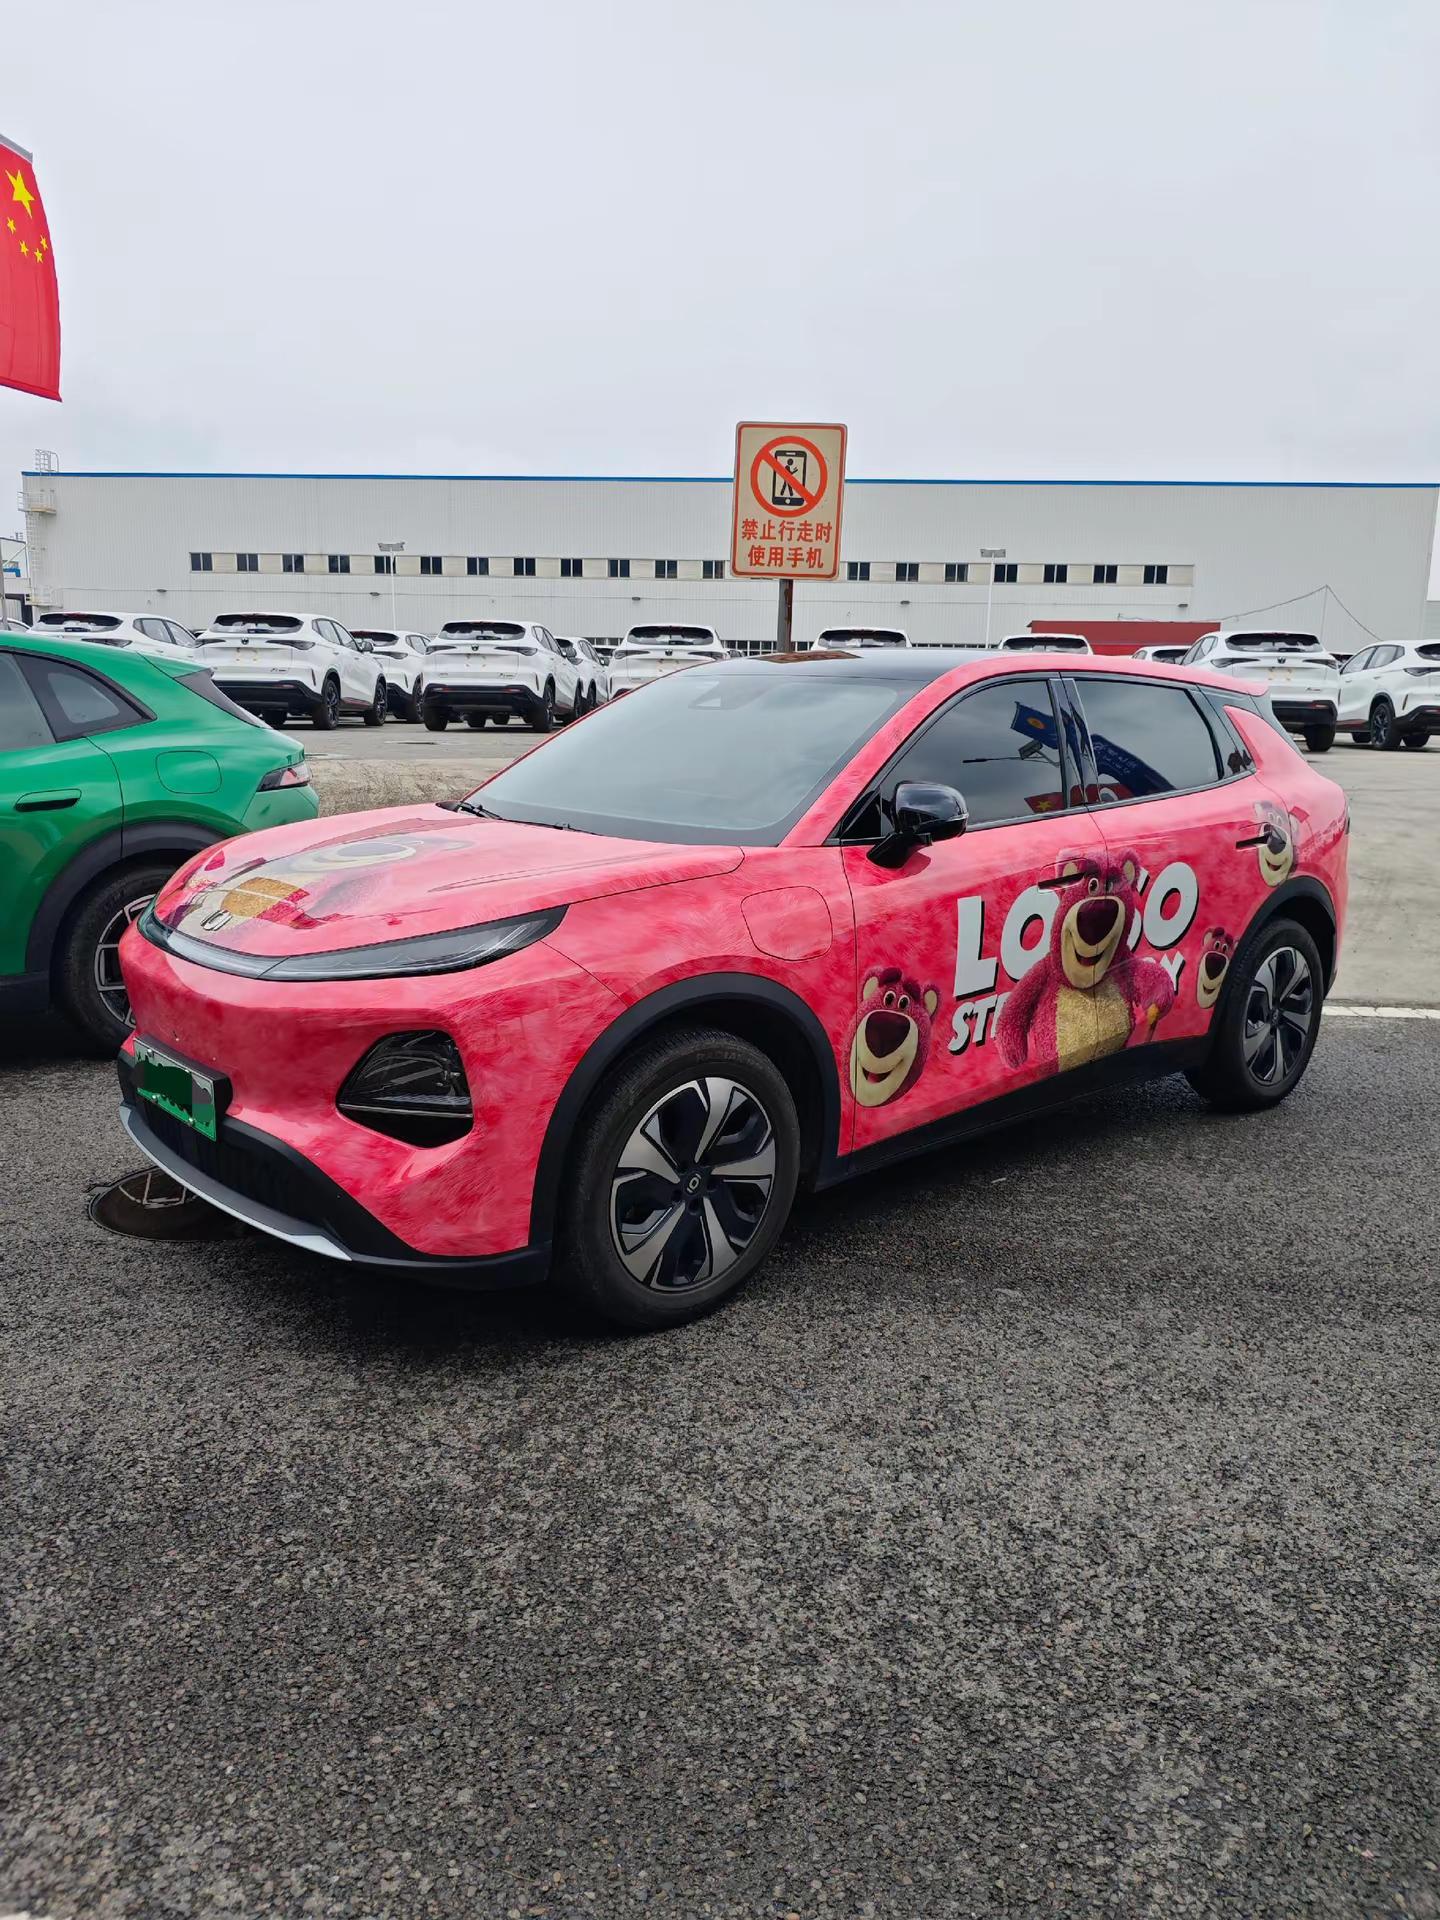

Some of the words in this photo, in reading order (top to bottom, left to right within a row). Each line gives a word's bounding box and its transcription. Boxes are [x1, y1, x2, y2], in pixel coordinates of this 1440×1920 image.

[741, 518, 832, 543] 禁止行走时
[747, 544, 824, 569] 使用手机
[953, 861, 1199, 1001] LOO
